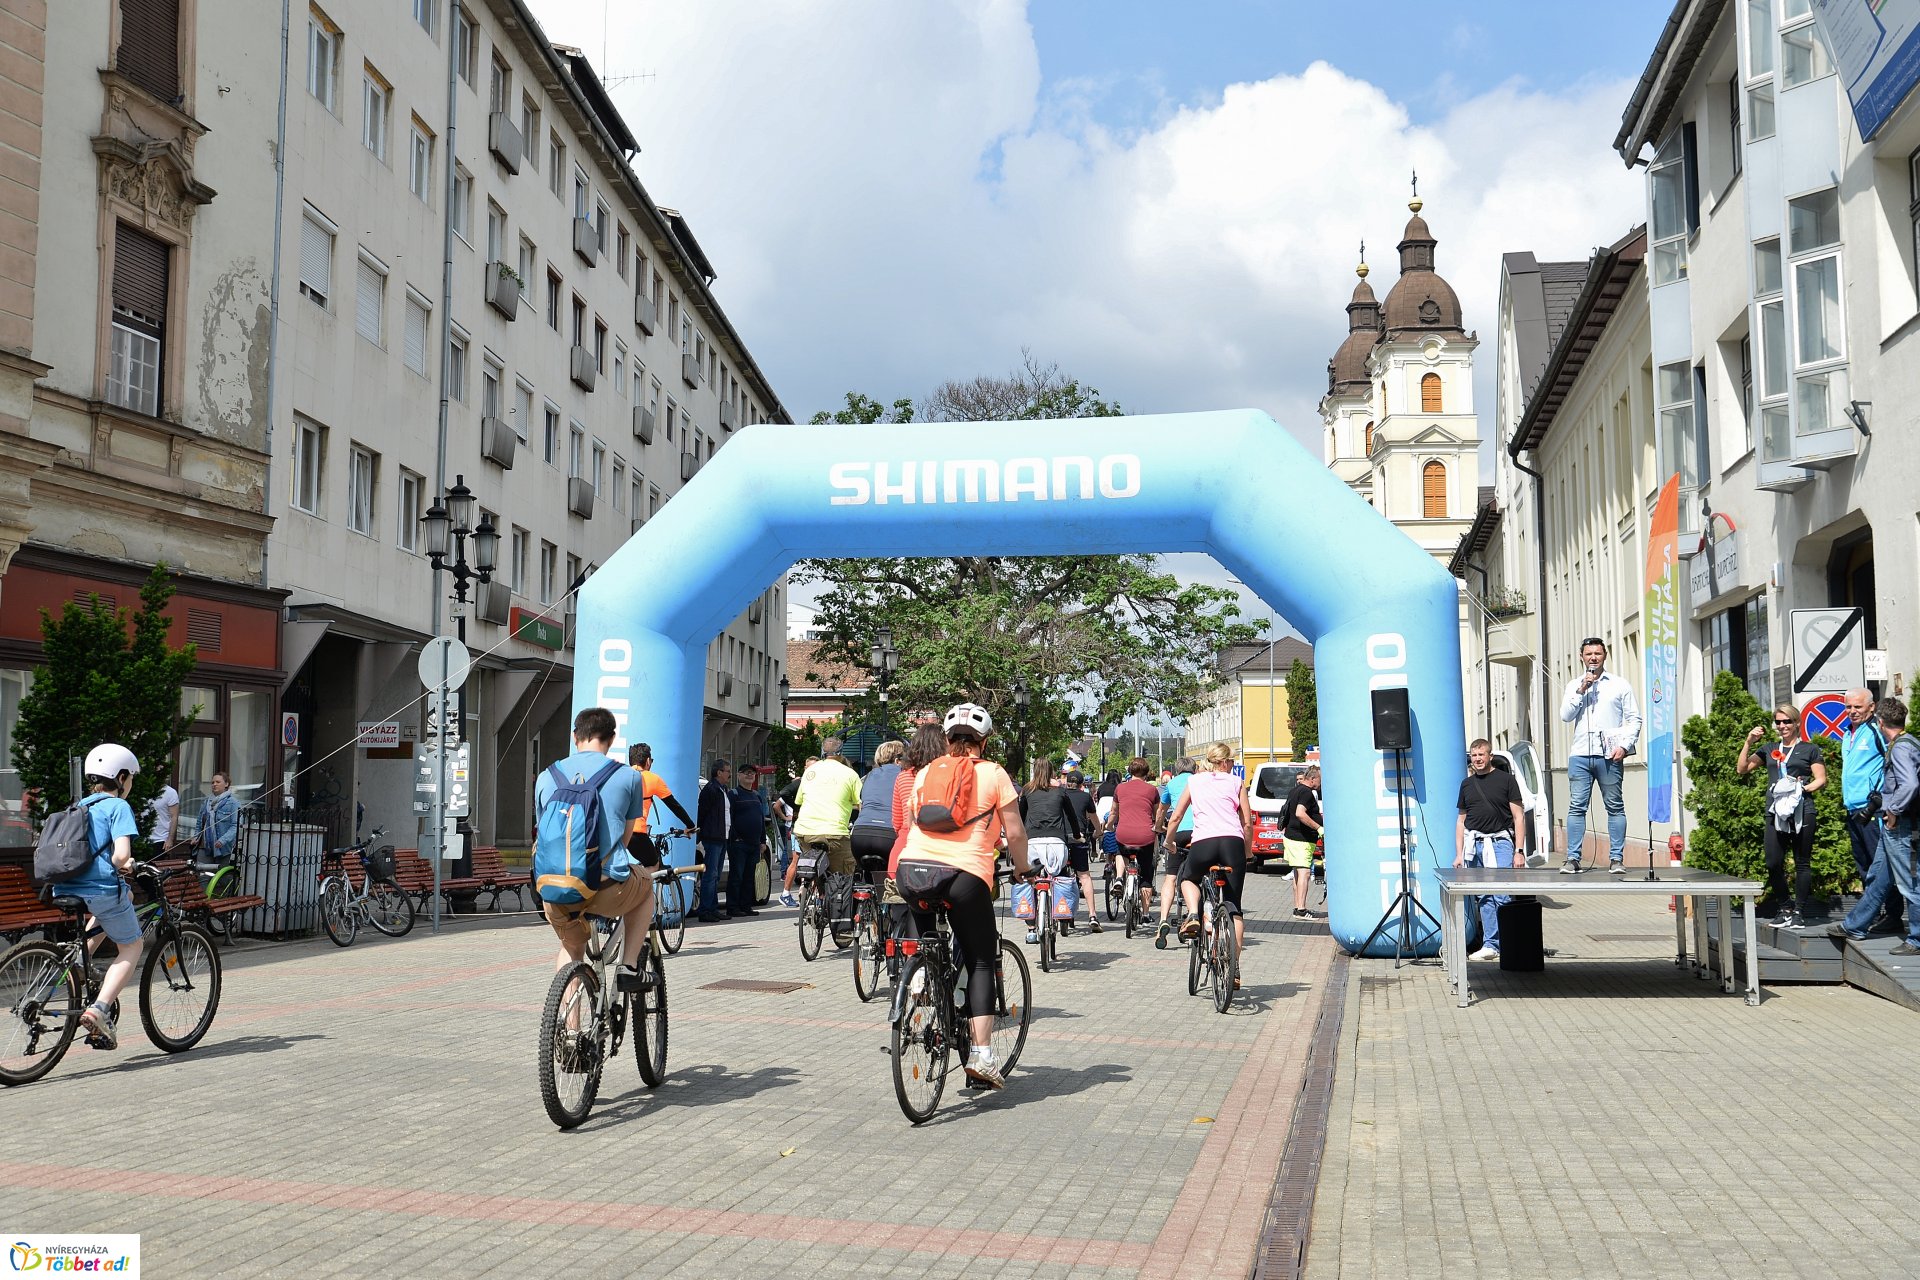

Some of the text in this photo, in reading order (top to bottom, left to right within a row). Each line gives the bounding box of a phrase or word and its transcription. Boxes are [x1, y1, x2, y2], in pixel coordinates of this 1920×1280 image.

[829, 454, 1141, 505] SHIMANO
[360, 724, 397, 735] VIGYÁZZ
[360, 736, 397, 744] AUTÓKIJÁRAT
